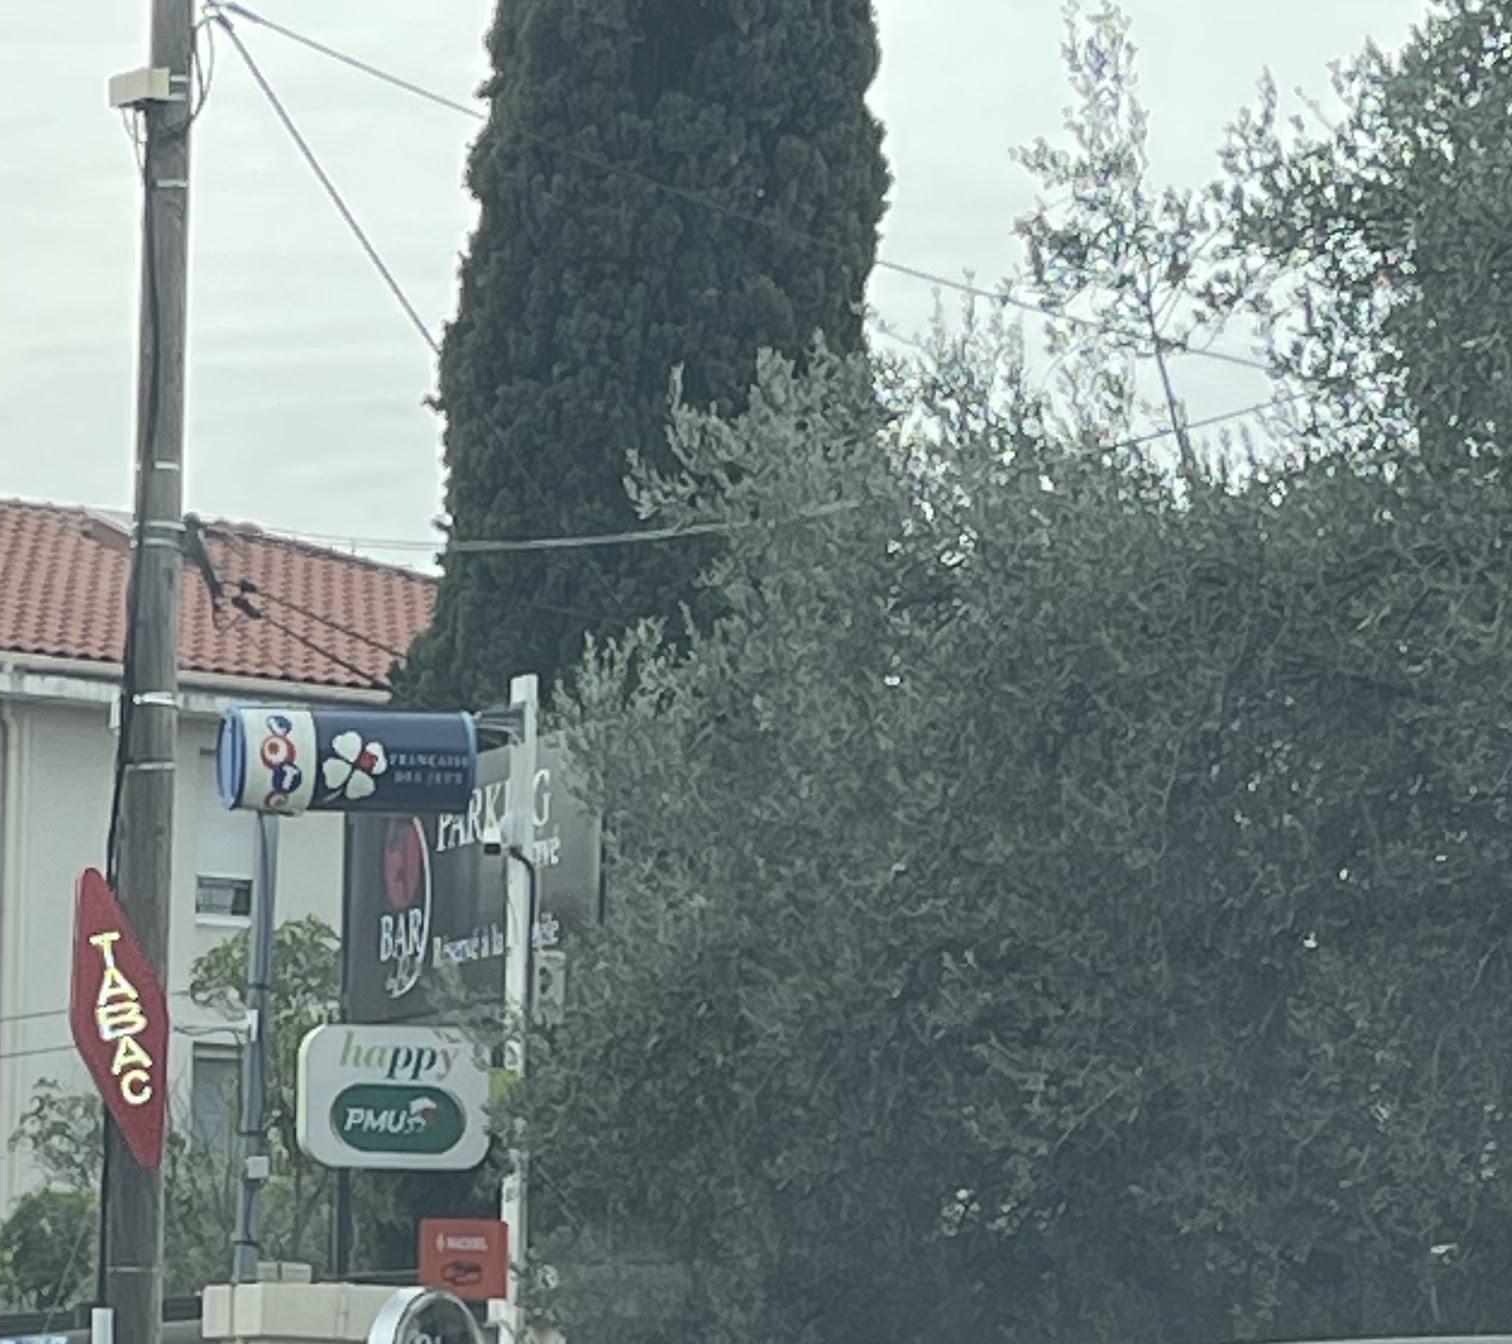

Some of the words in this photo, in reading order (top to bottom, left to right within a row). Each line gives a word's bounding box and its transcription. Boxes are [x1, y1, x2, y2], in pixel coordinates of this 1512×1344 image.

[436, 769, 552, 852] PARKIG
[380, 908, 423, 962] BAR
[88, 931, 153, 1105] TABAC
[339, 1029, 459, 1082] happy
[344, 1107, 408, 1134] PMU
